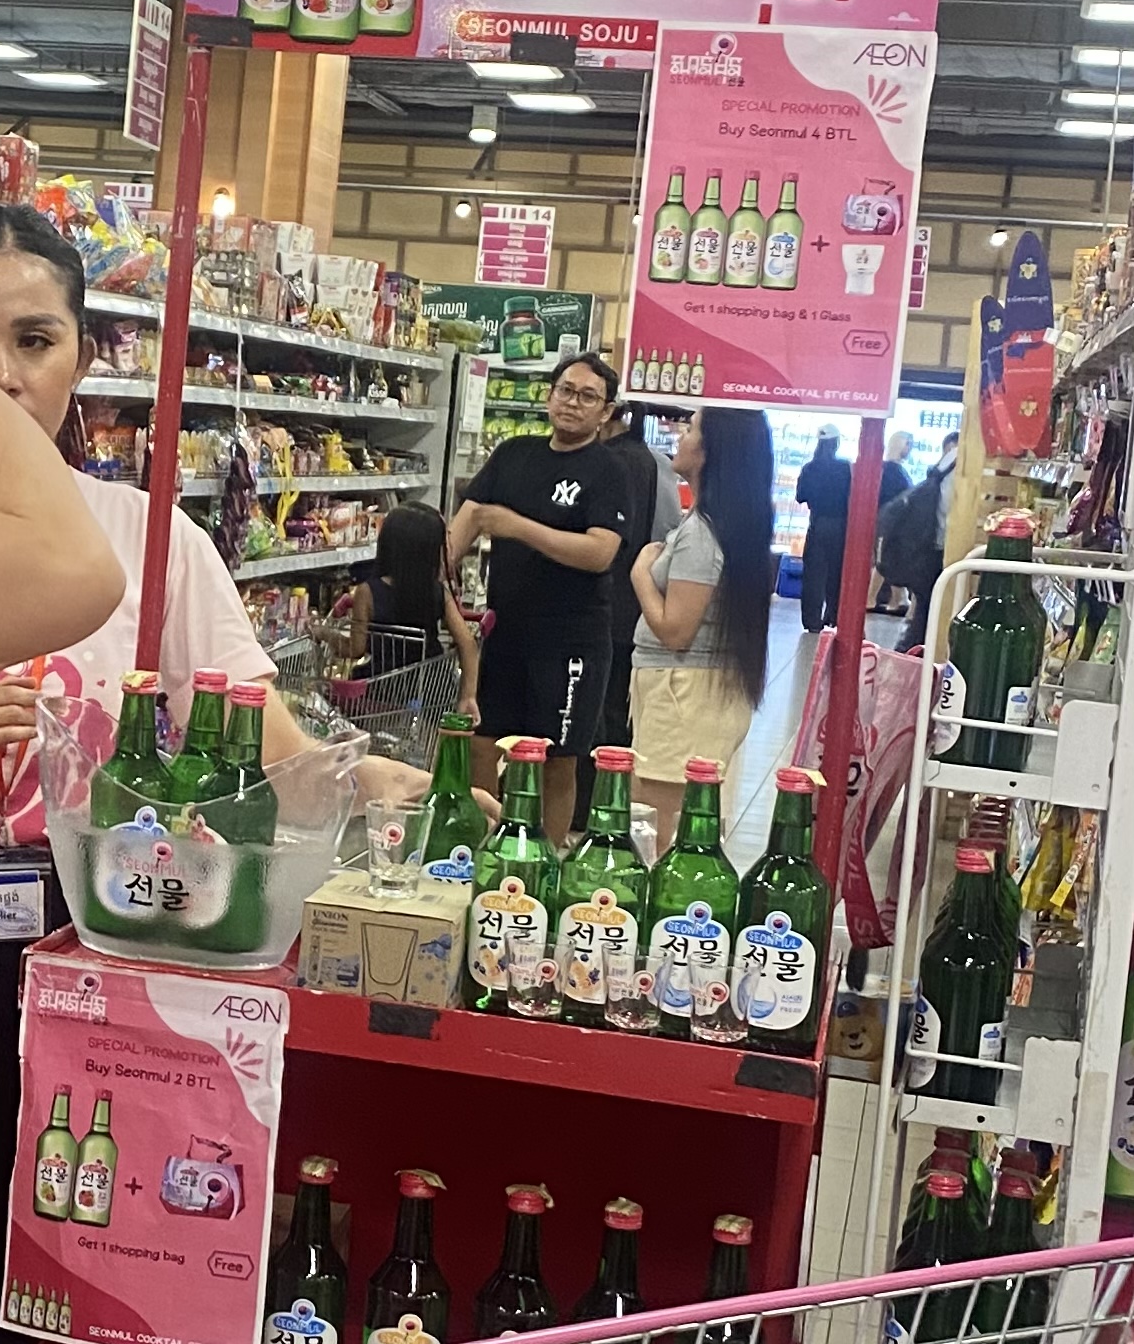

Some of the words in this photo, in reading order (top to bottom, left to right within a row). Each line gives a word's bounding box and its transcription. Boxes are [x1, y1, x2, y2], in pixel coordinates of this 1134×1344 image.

[579, 23, 639, 42] SOJU
[721, 99, 777, 113] SPECIAL
[780, 101, 861, 117] PROMOTION
[719, 122, 746, 137] Buy
[749, 123, 808, 140] Seonmul
[811, 125, 821, 140] 4
[825, 126, 857, 141] BTL
[532, 209, 552, 222] 14
[683, 301, 706, 315] Get
[716, 305, 771, 320] shopping
[772, 308, 796, 322] bag
[798, 309, 808, 320] &
[819, 310, 852, 323] Glass
[851, 336, 882, 350] Free
[722, 382, 771, 395] SEONMUL
[852, 390, 879, 402] SOJU
[551, 479, 582, 506] NY
[431, 864, 474, 879] SEONMU
[124, 873, 190, 912] 선물
[312, 909, 349, 922] UNION
[477, 909, 538, 943] 선물
[666, 921, 719, 937] SEONMUL
[567, 921, 629, 954] 선물
[747, 930, 800, 949] SEONMUL
[660, 935, 722, 968] 선물
[742, 944, 805, 983] 선물
[87, 1036, 138, 1055] SPECIAL
[144, 1045, 221, 1067] PROMOTION
[85, 1058, 111, 1076] Buy
[115, 1064, 171, 1084] Seonmul
[174, 1073, 183, 1086] 2
[186, 1075, 216, 1091] BTL
[77, 1236, 98, 1250] Get
[108, 1242, 160, 1263] shopping
[163, 1250, 186, 1266] bag
[214, 1257, 244, 1274] Free
[88, 1325, 134, 1344] SEONMUL
